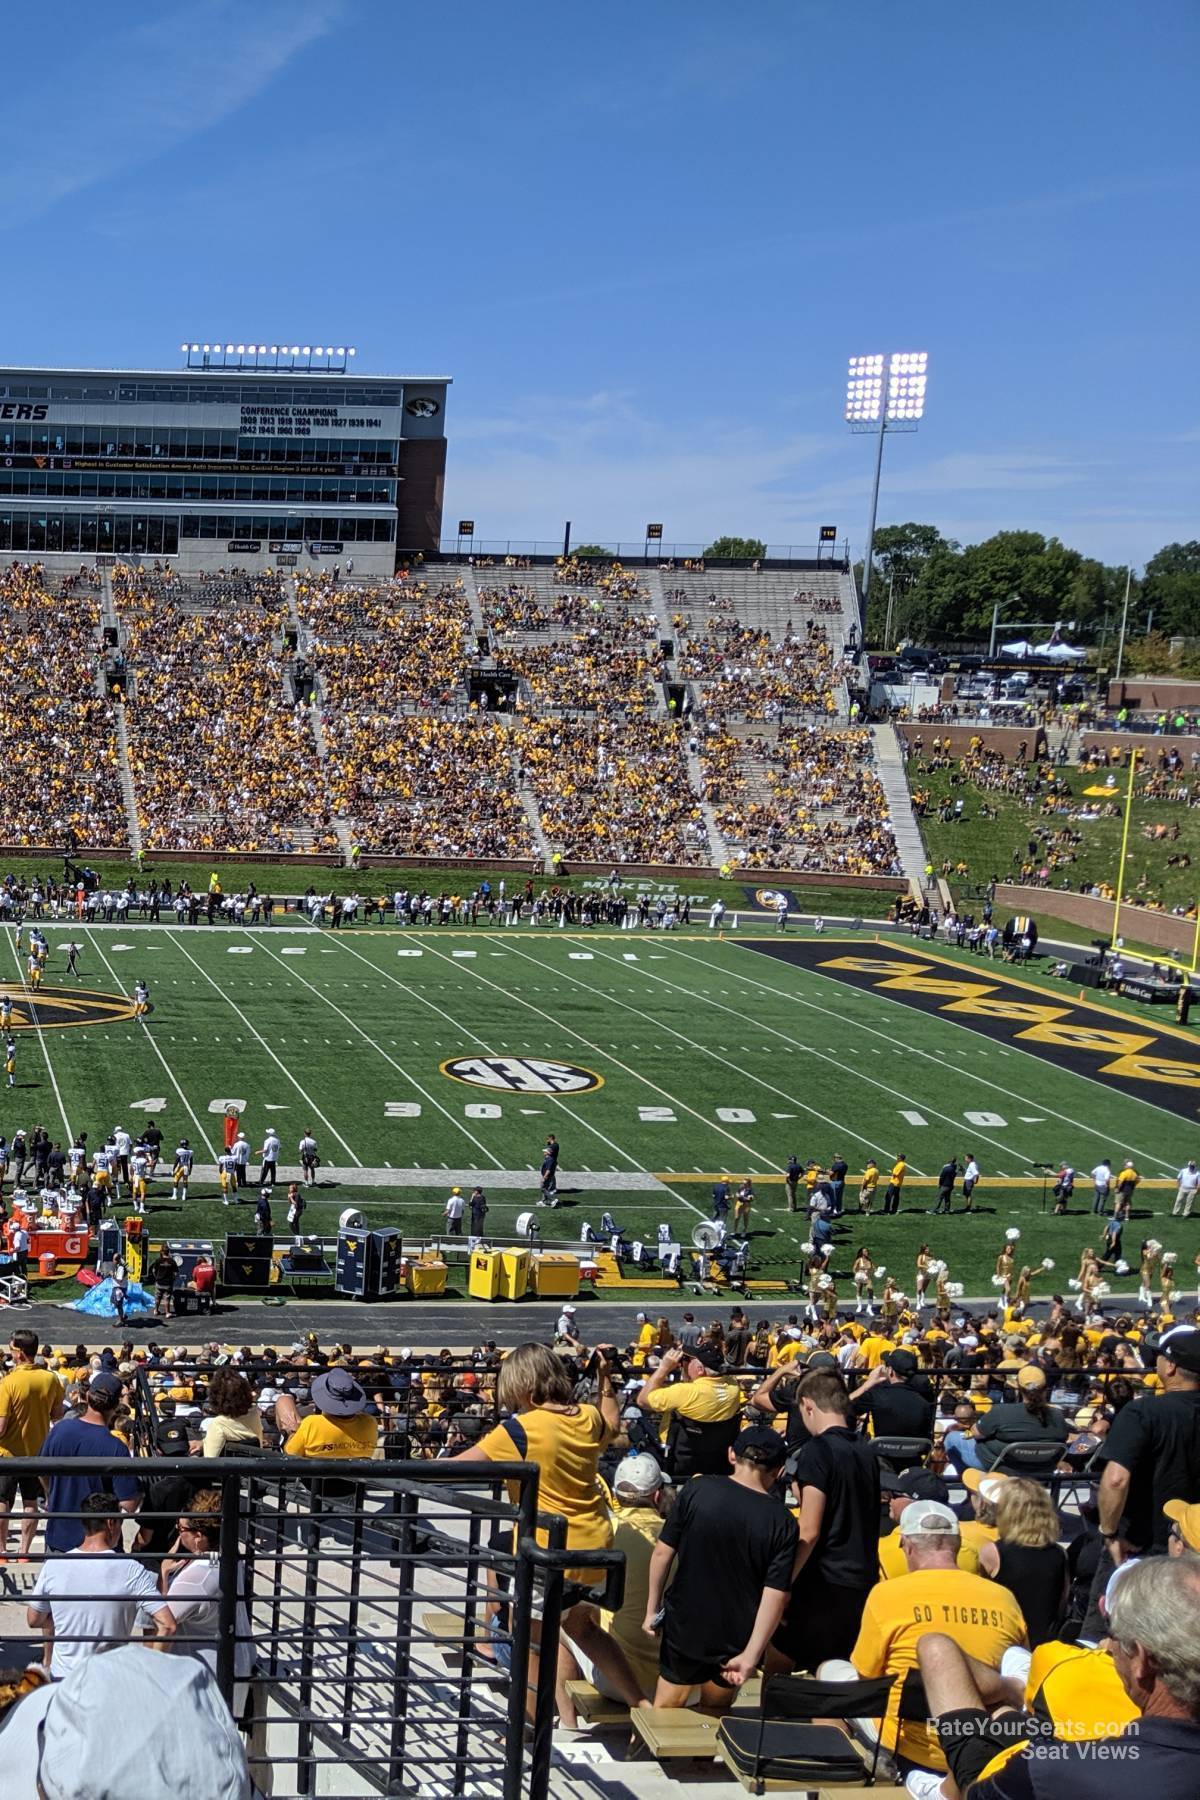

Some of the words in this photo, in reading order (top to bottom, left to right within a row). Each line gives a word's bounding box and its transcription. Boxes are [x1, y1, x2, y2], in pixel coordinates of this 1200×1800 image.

[240, 407, 289, 416] CONFERENCE
[291, 408, 338, 417] CHAMPIONS
[64, 1237, 81, 1255] G
[913, 1605, 932, 1623] GO
[942, 1605, 1004, 1628] TIGERS!
